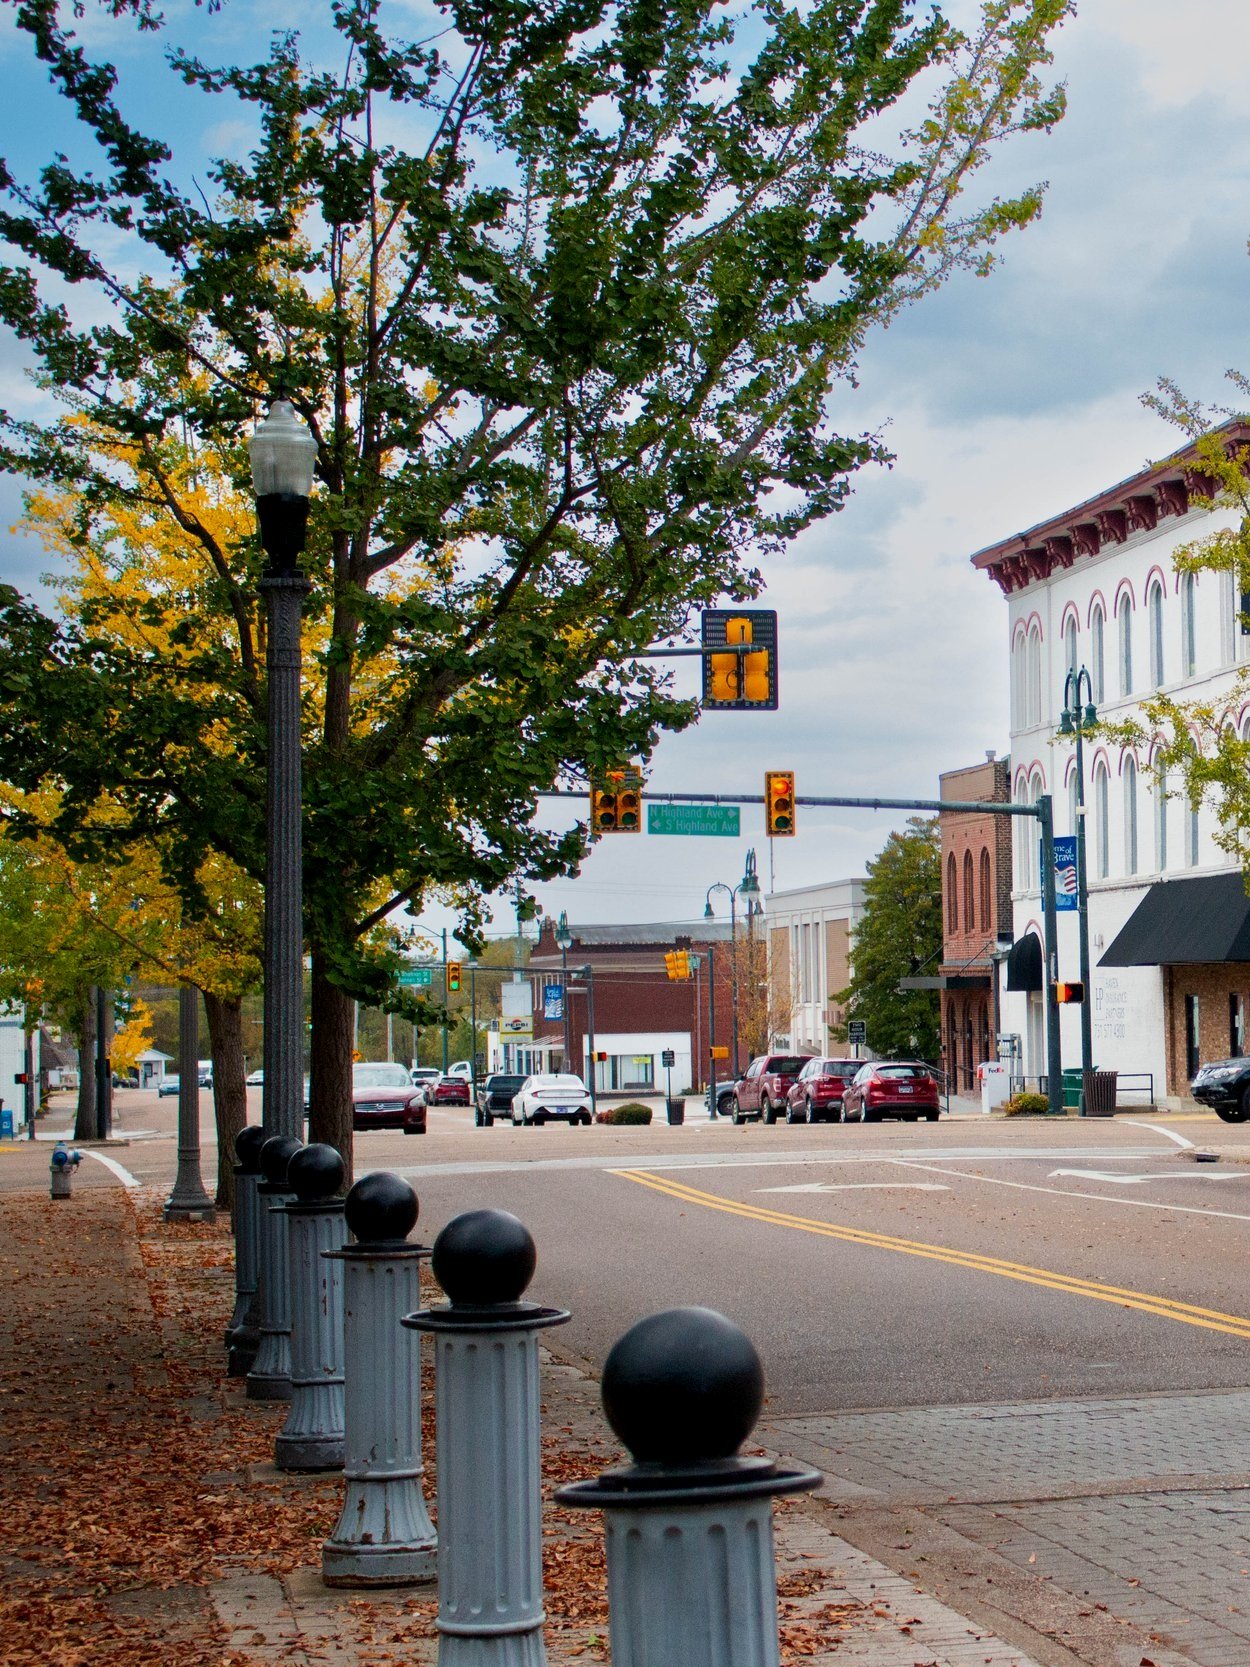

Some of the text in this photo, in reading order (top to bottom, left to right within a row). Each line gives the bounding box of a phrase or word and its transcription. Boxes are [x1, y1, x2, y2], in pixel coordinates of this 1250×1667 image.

[650, 806, 723, 821] N Highland Ave
[665, 820, 738, 835] S Highland Ave
[1065, 845, 1073, 854] of
